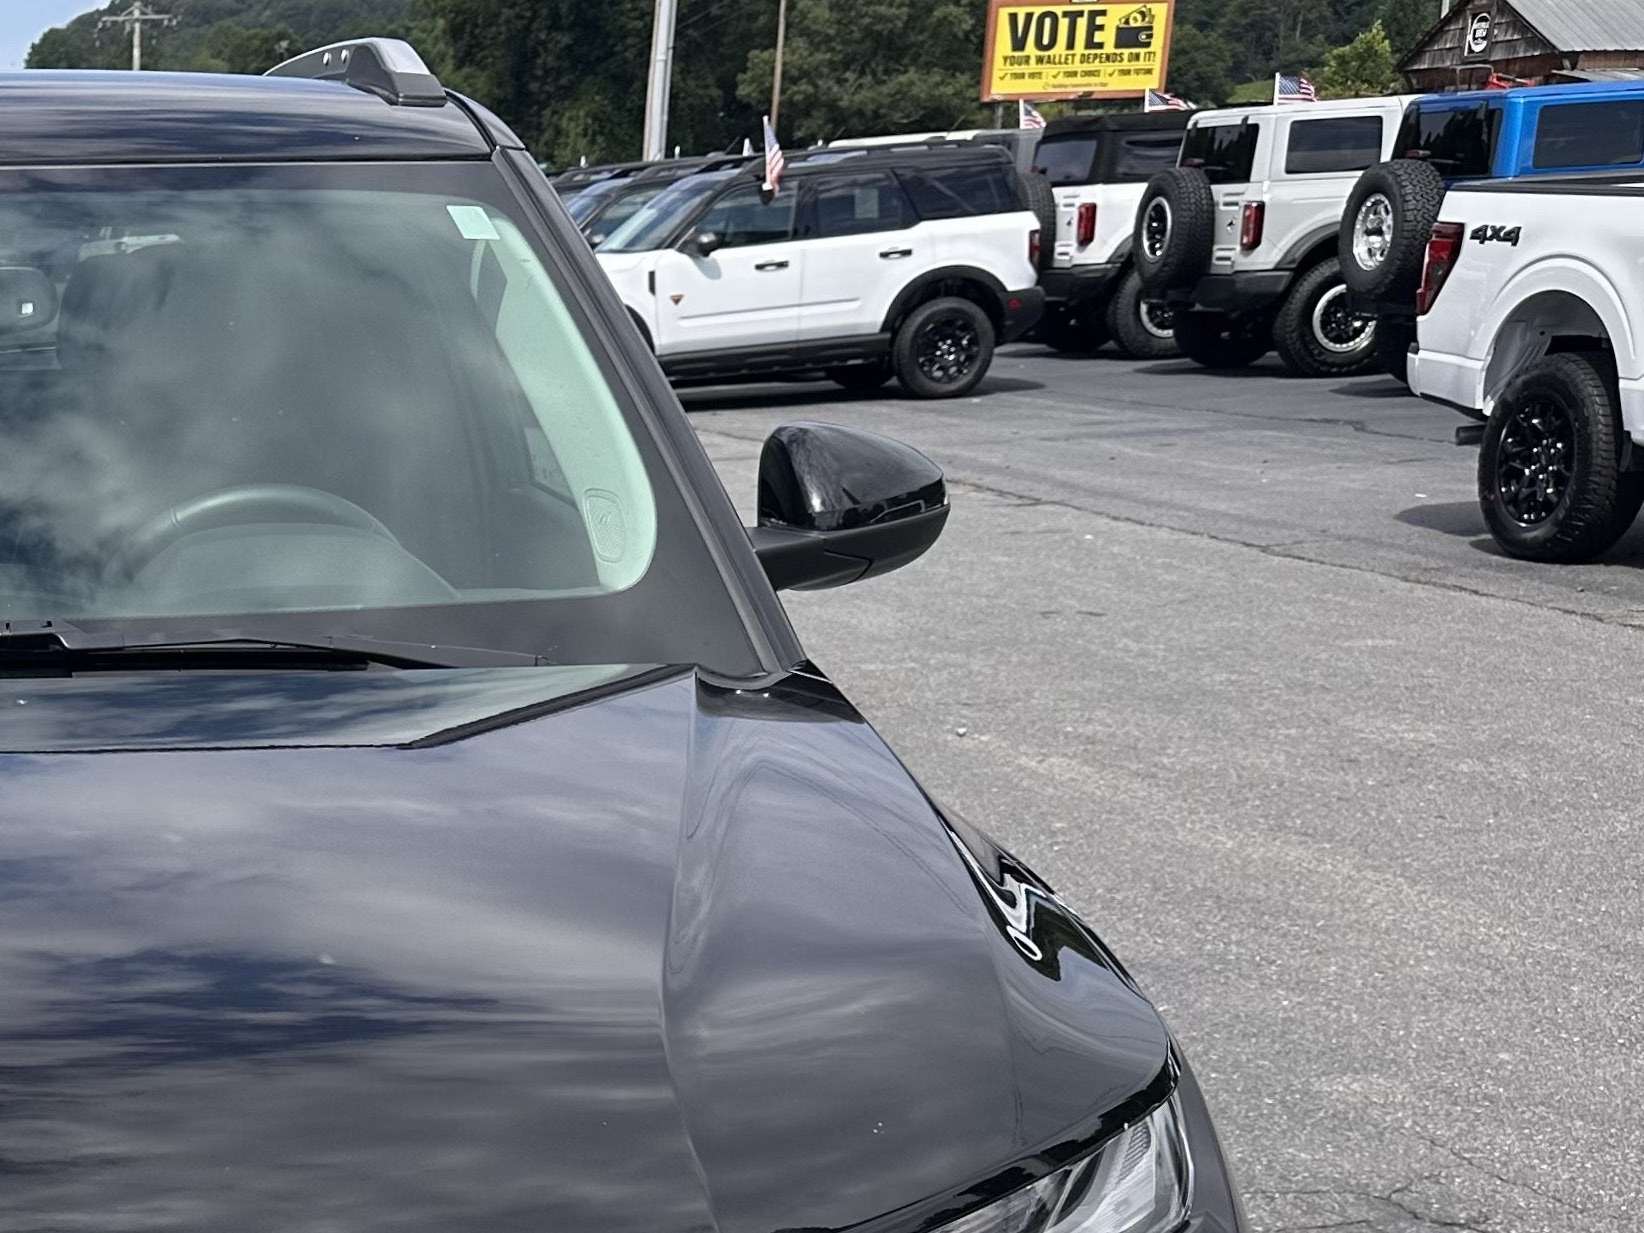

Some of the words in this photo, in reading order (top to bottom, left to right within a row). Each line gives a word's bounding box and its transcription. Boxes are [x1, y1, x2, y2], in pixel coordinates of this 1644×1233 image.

[1008, 9, 1108, 52] VOTE
[1002, 55, 1031, 67] YOUR
[1035, 53, 1077, 66] WALLET
[1079, 52, 1125, 64] DEPENDS
[1127, 51, 1141, 63] ON
[1143, 51, 1156, 62] IT!
